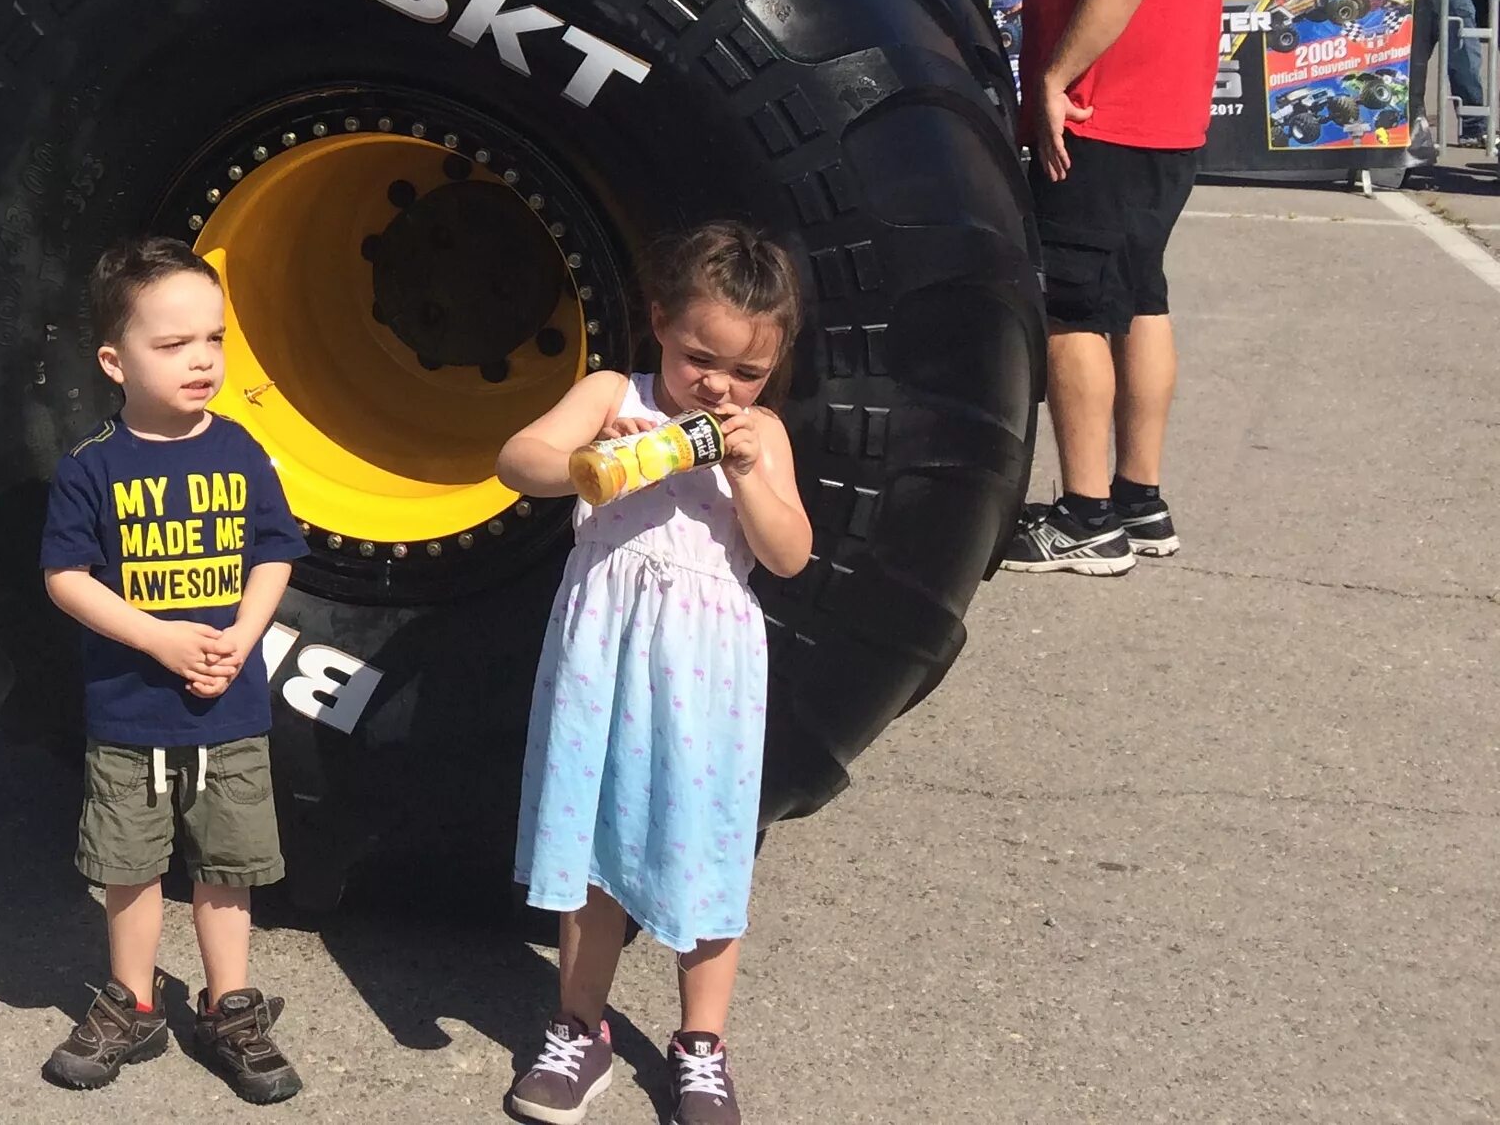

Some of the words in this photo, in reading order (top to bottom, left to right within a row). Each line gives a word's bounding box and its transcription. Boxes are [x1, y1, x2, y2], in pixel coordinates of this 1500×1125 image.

[1295, 37, 1347, 67] 2003
[1269, 67, 1308, 86] Official
[1311, 57, 1361, 77] Souvenir
[689, 427, 709, 458] Maid
[696, 418, 717, 460] Minute
[113, 477, 167, 520] MY
[187, 472, 247, 513] DAD
[120, 519, 204, 557] MADE
[216, 517, 245, 551] ME
[130, 564, 239, 601] AWESOME
